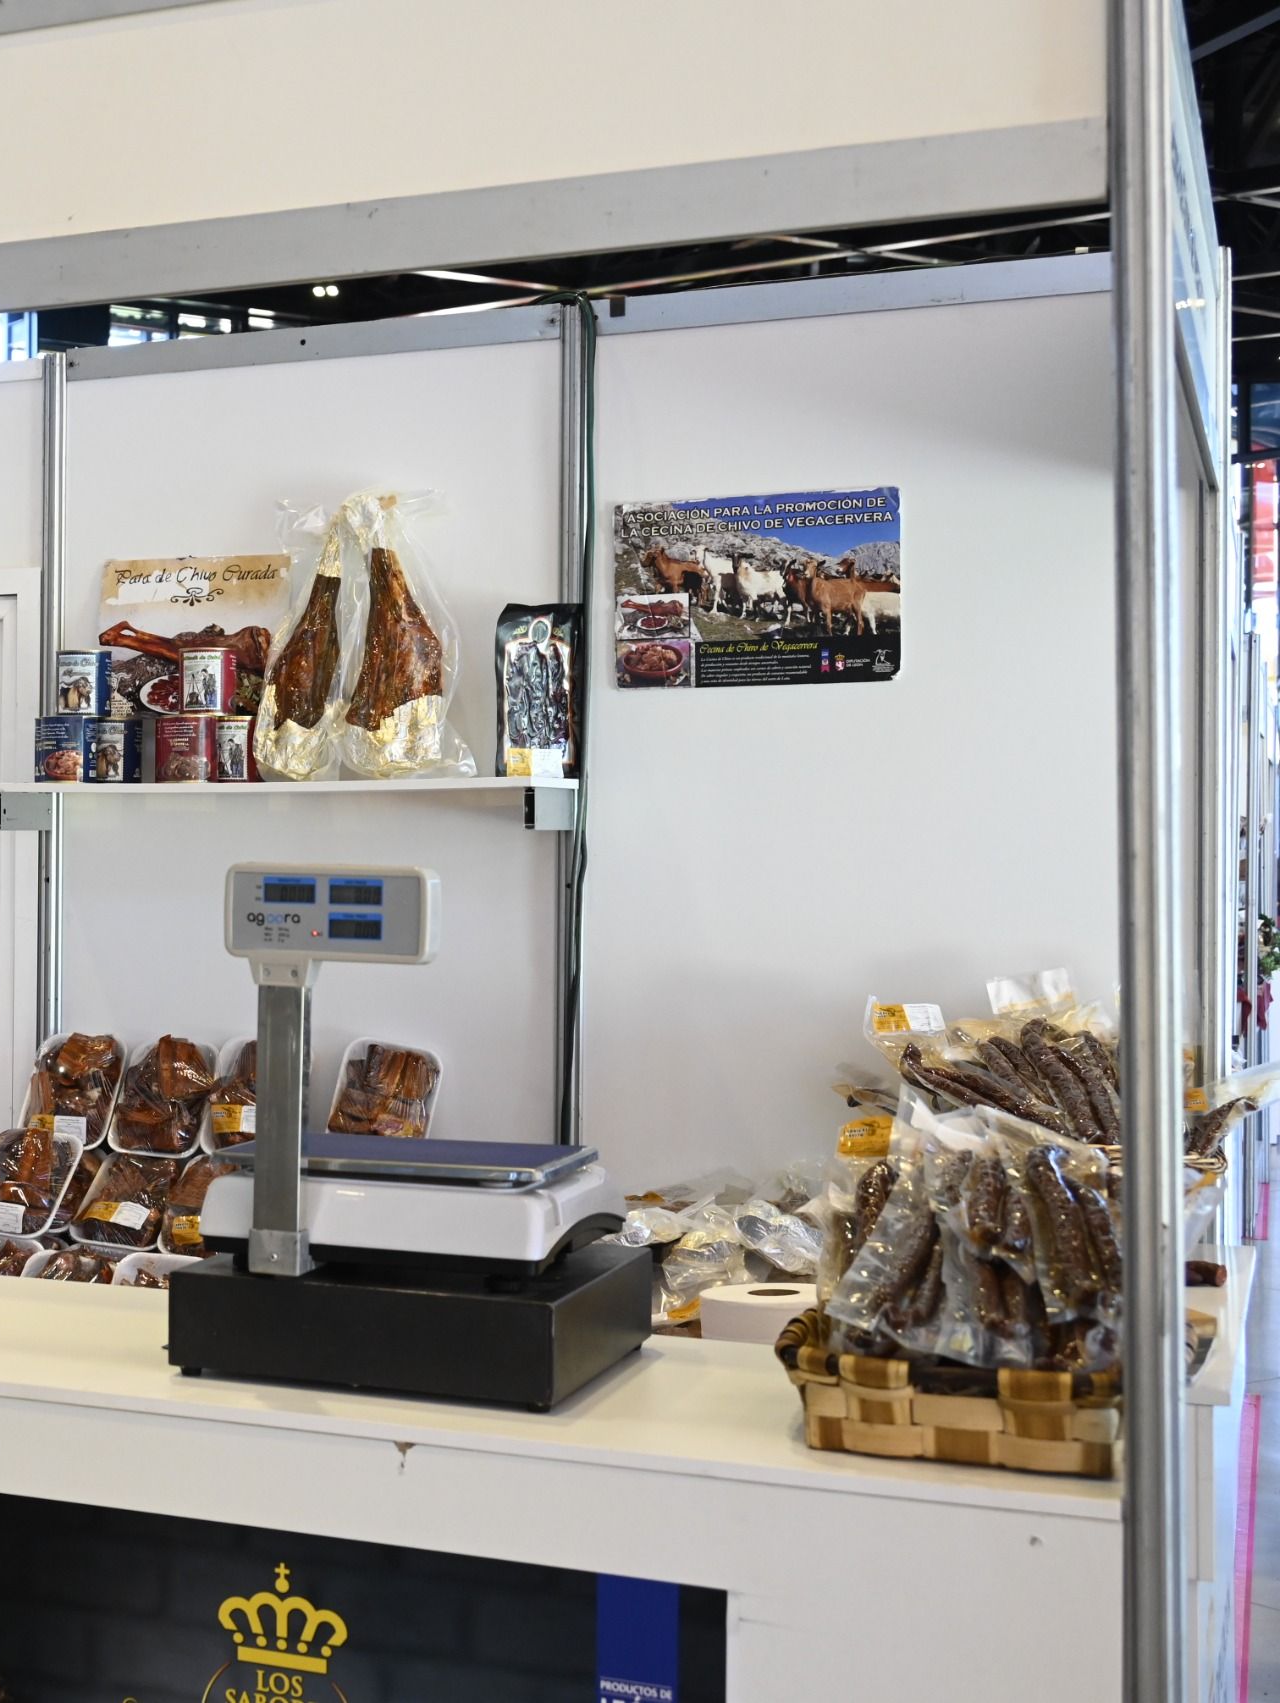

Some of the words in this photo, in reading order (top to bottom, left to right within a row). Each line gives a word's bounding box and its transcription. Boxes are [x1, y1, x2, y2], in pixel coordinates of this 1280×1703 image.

[627, 506, 711, 523] ASOCIACIÓN
[713, 505, 751, 518] PARA
[753, 504, 772, 516] LA
[776, 497, 865, 514] PROMOCIÓN
[867, 496, 887, 508] DE
[620, 525, 639, 538] LA
[641, 522, 693, 537] CECINA
[696, 520, 716, 534] DE
[717, 518, 761, 533] CHIVO
[764, 517, 784, 530] DE
[785, 511, 893, 529] VEGACERVERA
[154, 568, 172, 583] de
[176, 566, 218, 584] Chivo
[222, 564, 279, 582] Curada
[699, 643, 724, 654] Cecina
[725, 643, 735, 653] de
[736, 642, 759, 653] Chivo
[759, 642, 769, 652] de
[770, 640, 819, 654] Vegacervera
[256, 1669, 304, 1697] LOS
[600, 1679, 658, 1698] PRODUCTOS
[660, 1688, 673, 1700] DE
